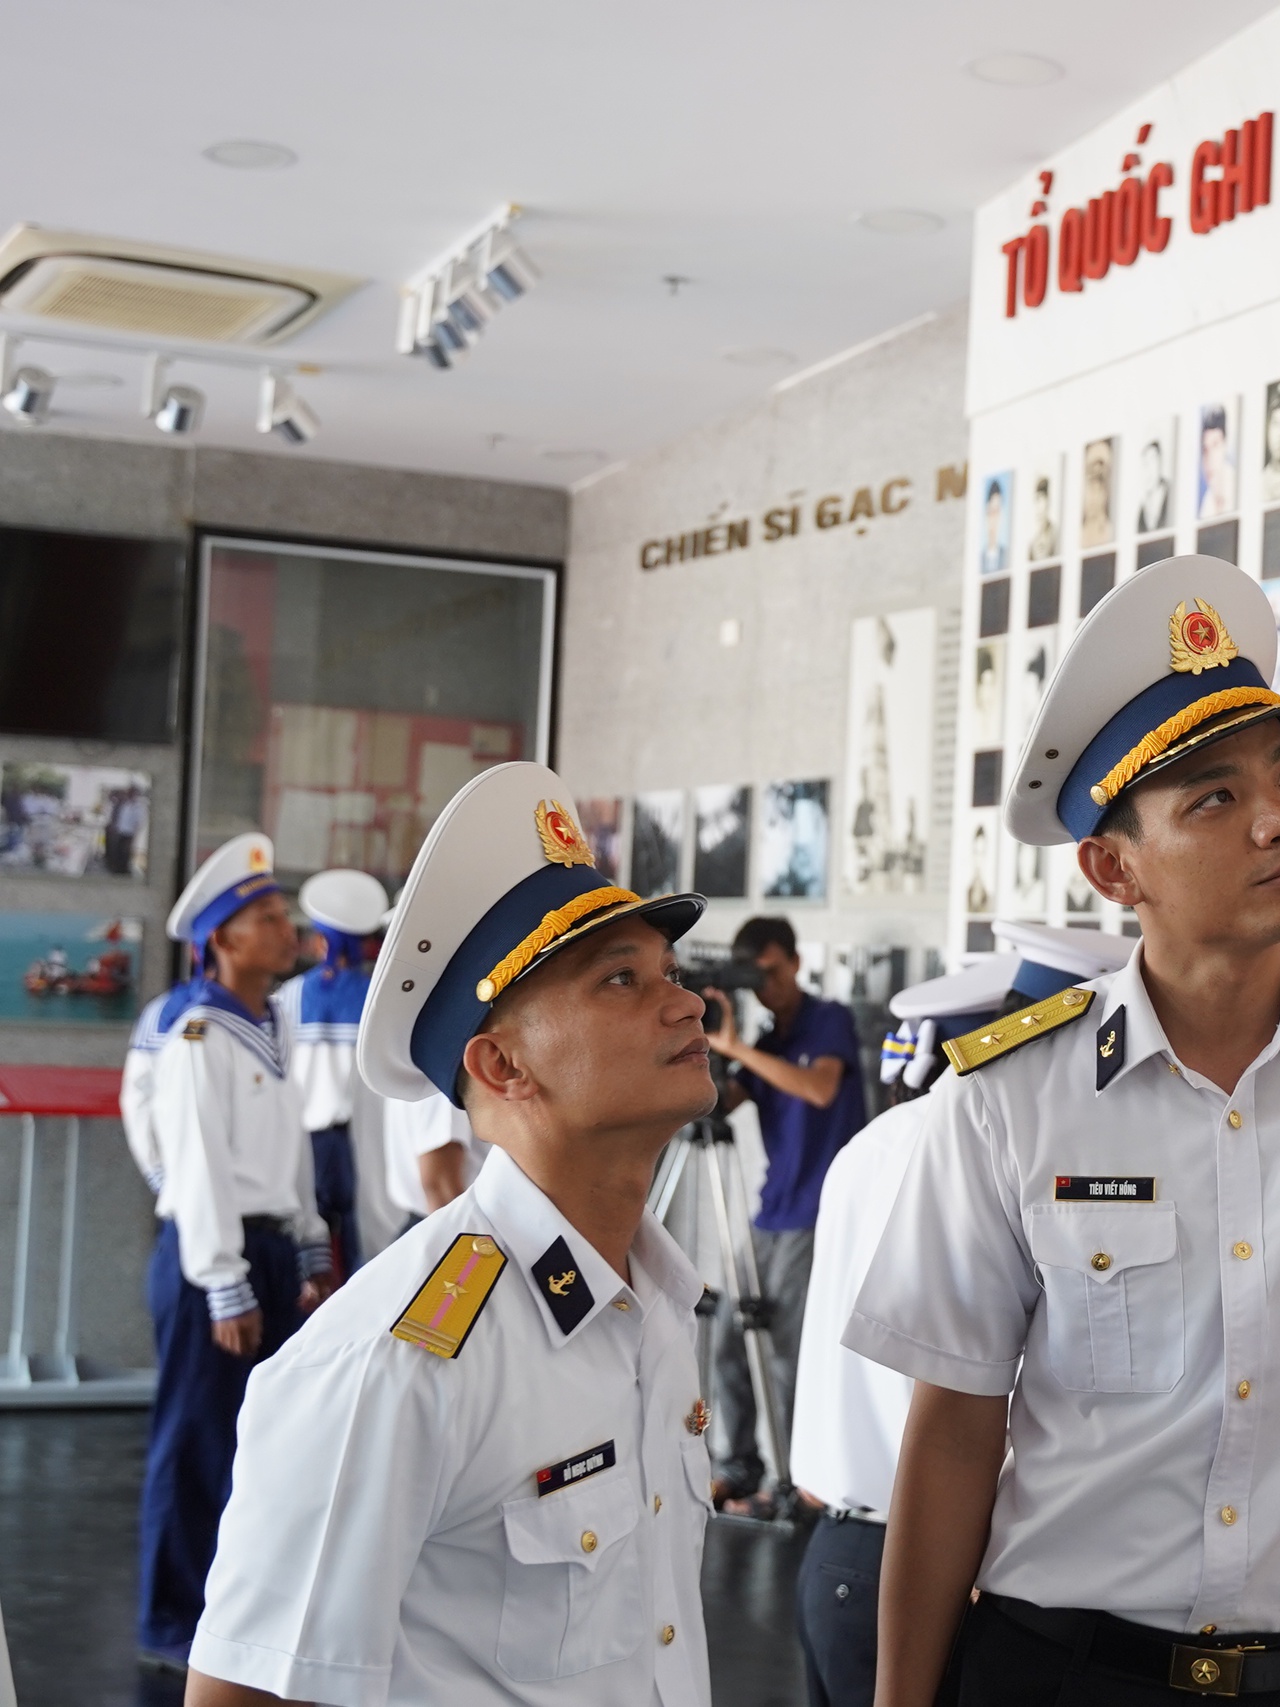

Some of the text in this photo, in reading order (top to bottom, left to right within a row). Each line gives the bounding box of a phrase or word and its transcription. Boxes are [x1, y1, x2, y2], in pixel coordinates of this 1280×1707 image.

[1001, 171, 1053, 317] TỔ
[1058, 123, 1173, 292] QUỐC
[1189, 111, 1274, 234] GHI
[640, 501, 750, 571] CHIẾN
[763, 488, 806, 542] SĨ
[815, 475, 912, 536] GẠC
[1089, 1181, 1103, 1195] TIÊU
[1104, 1179, 1118, 1195] VIẾT
